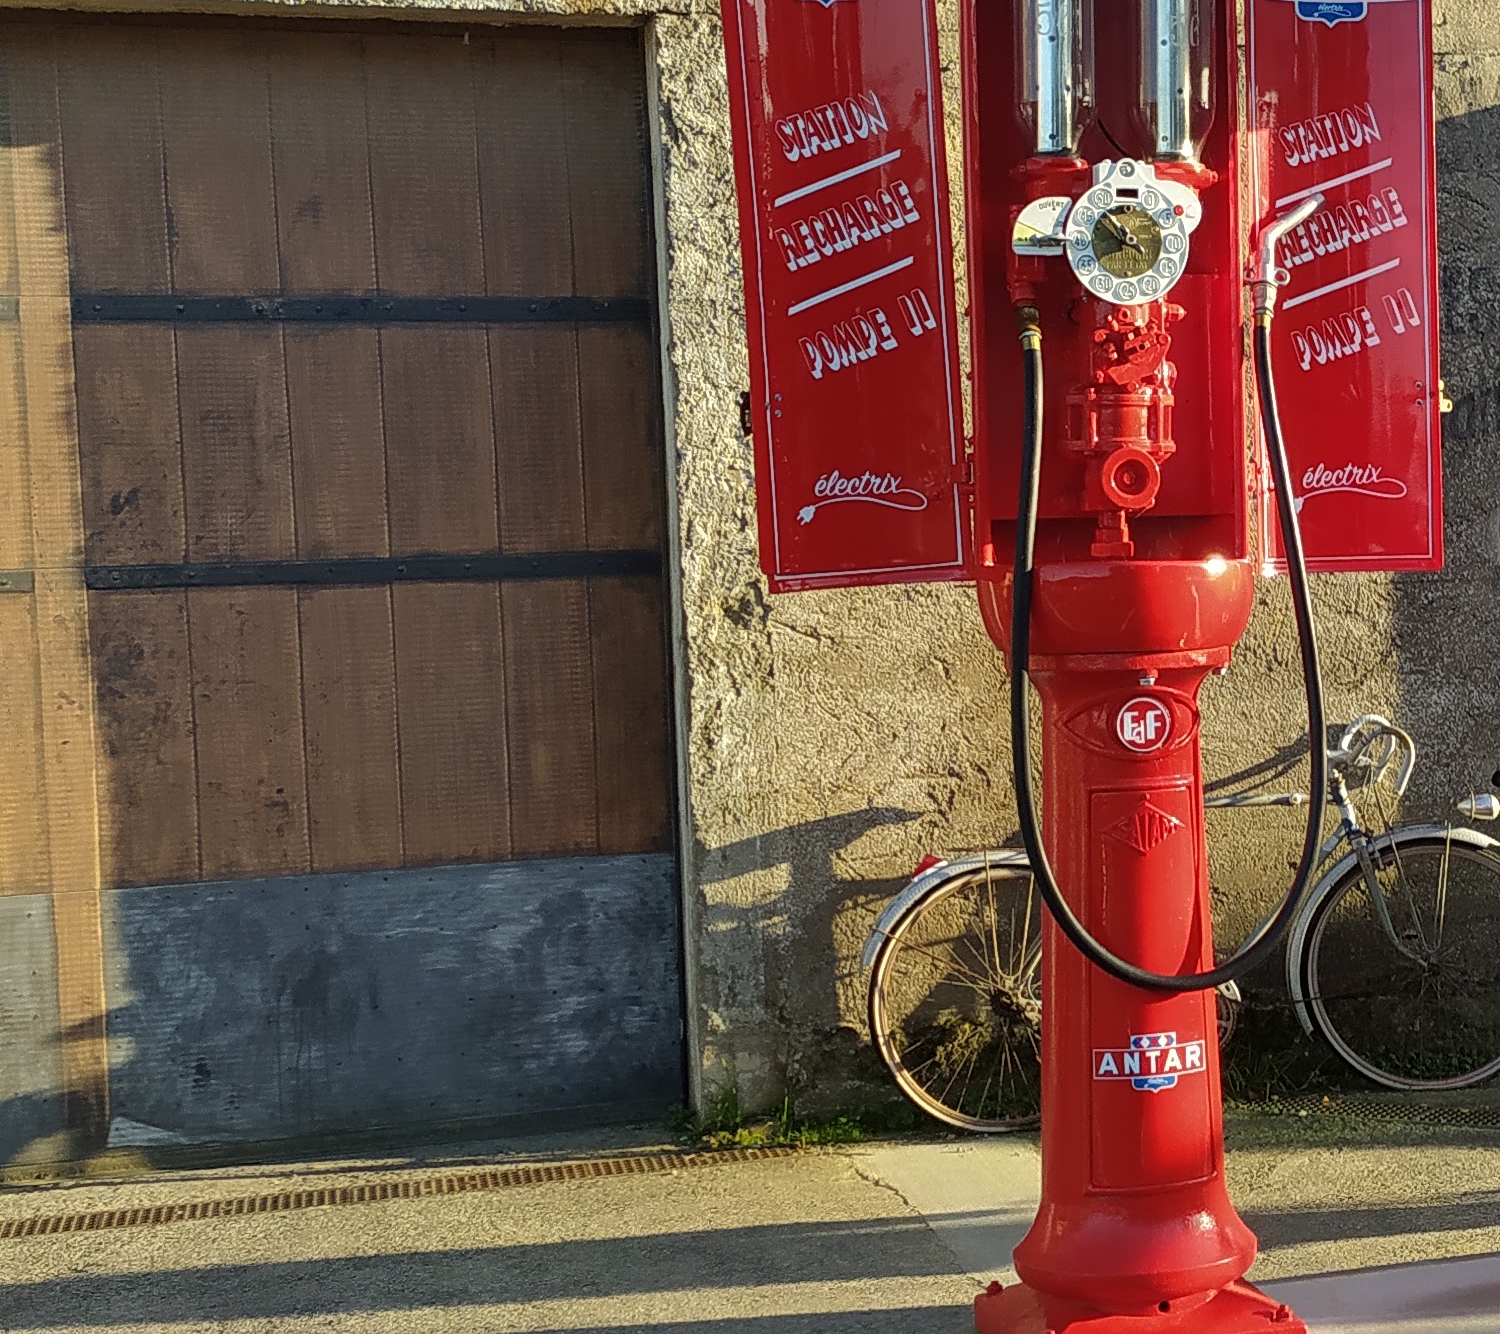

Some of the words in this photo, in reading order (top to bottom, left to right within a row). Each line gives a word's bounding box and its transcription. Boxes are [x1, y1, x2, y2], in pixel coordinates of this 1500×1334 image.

[774, 90, 889, 162] STATION
[1278, 101, 1381, 167] STATION
[774, 180, 920, 272] RECHARGE
[798, 307, 898, 380] POMPE
[1290, 305, 1381, 371] POMPE
[815, 469, 901, 497] électrix
[1303, 462, 1381, 488] électrix
[1123, 711, 1162, 744] EdF
[1098, 1045, 1201, 1075] ANTAR
